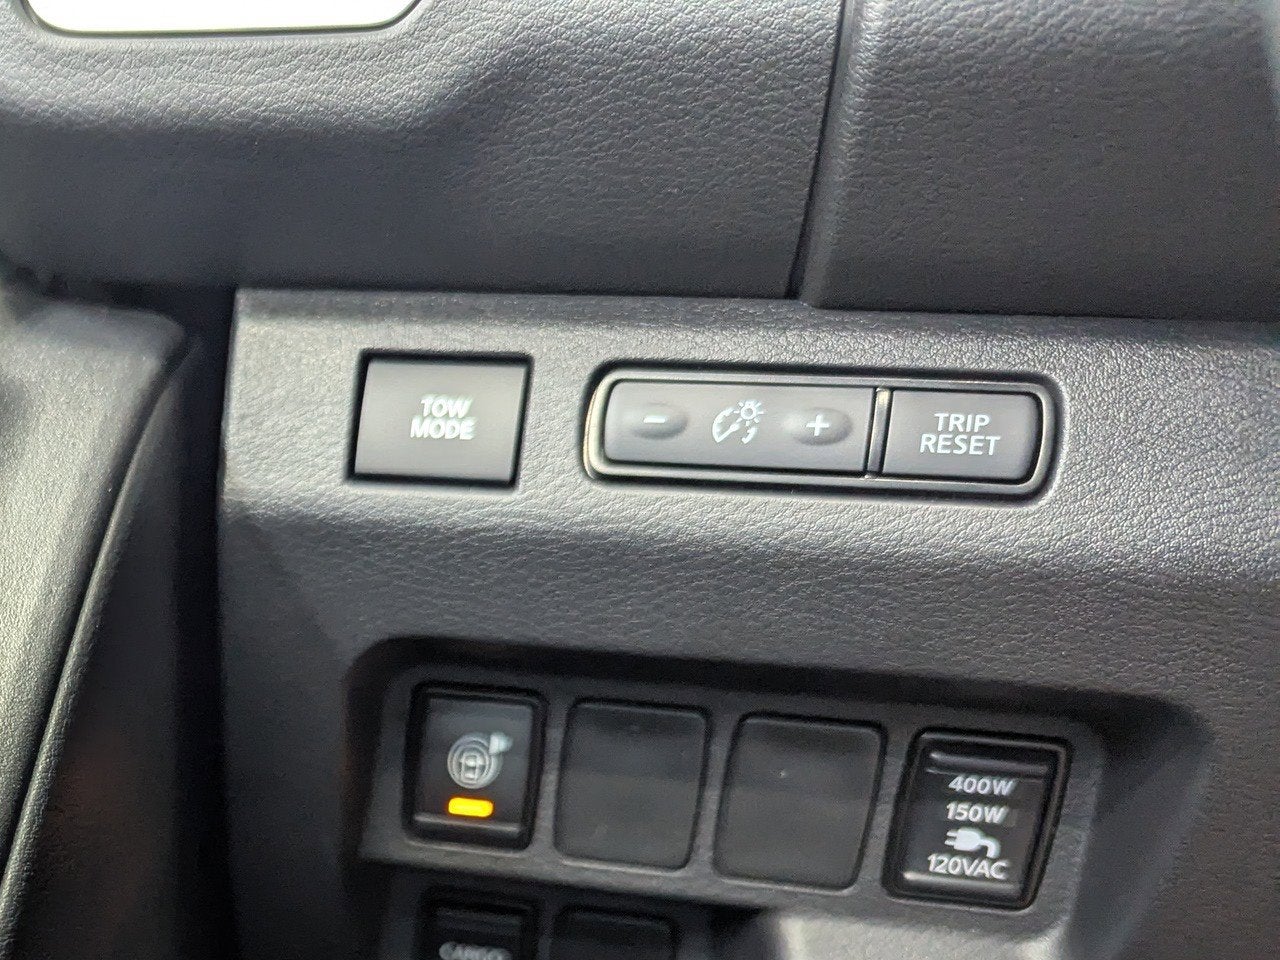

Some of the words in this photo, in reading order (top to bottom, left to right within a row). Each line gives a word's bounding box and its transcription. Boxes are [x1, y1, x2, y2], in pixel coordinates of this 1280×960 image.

[420, 394, 473, 418] TOW
[410, 416, 477, 440] MODE
[934, 413, 990, 432] TRIP
[920, 433, 1001, 455] RESET
[948, 775, 1016, 796] 400W
[946, 802, 1009, 823] 150W
[927, 853, 1008, 880] 120VAC
